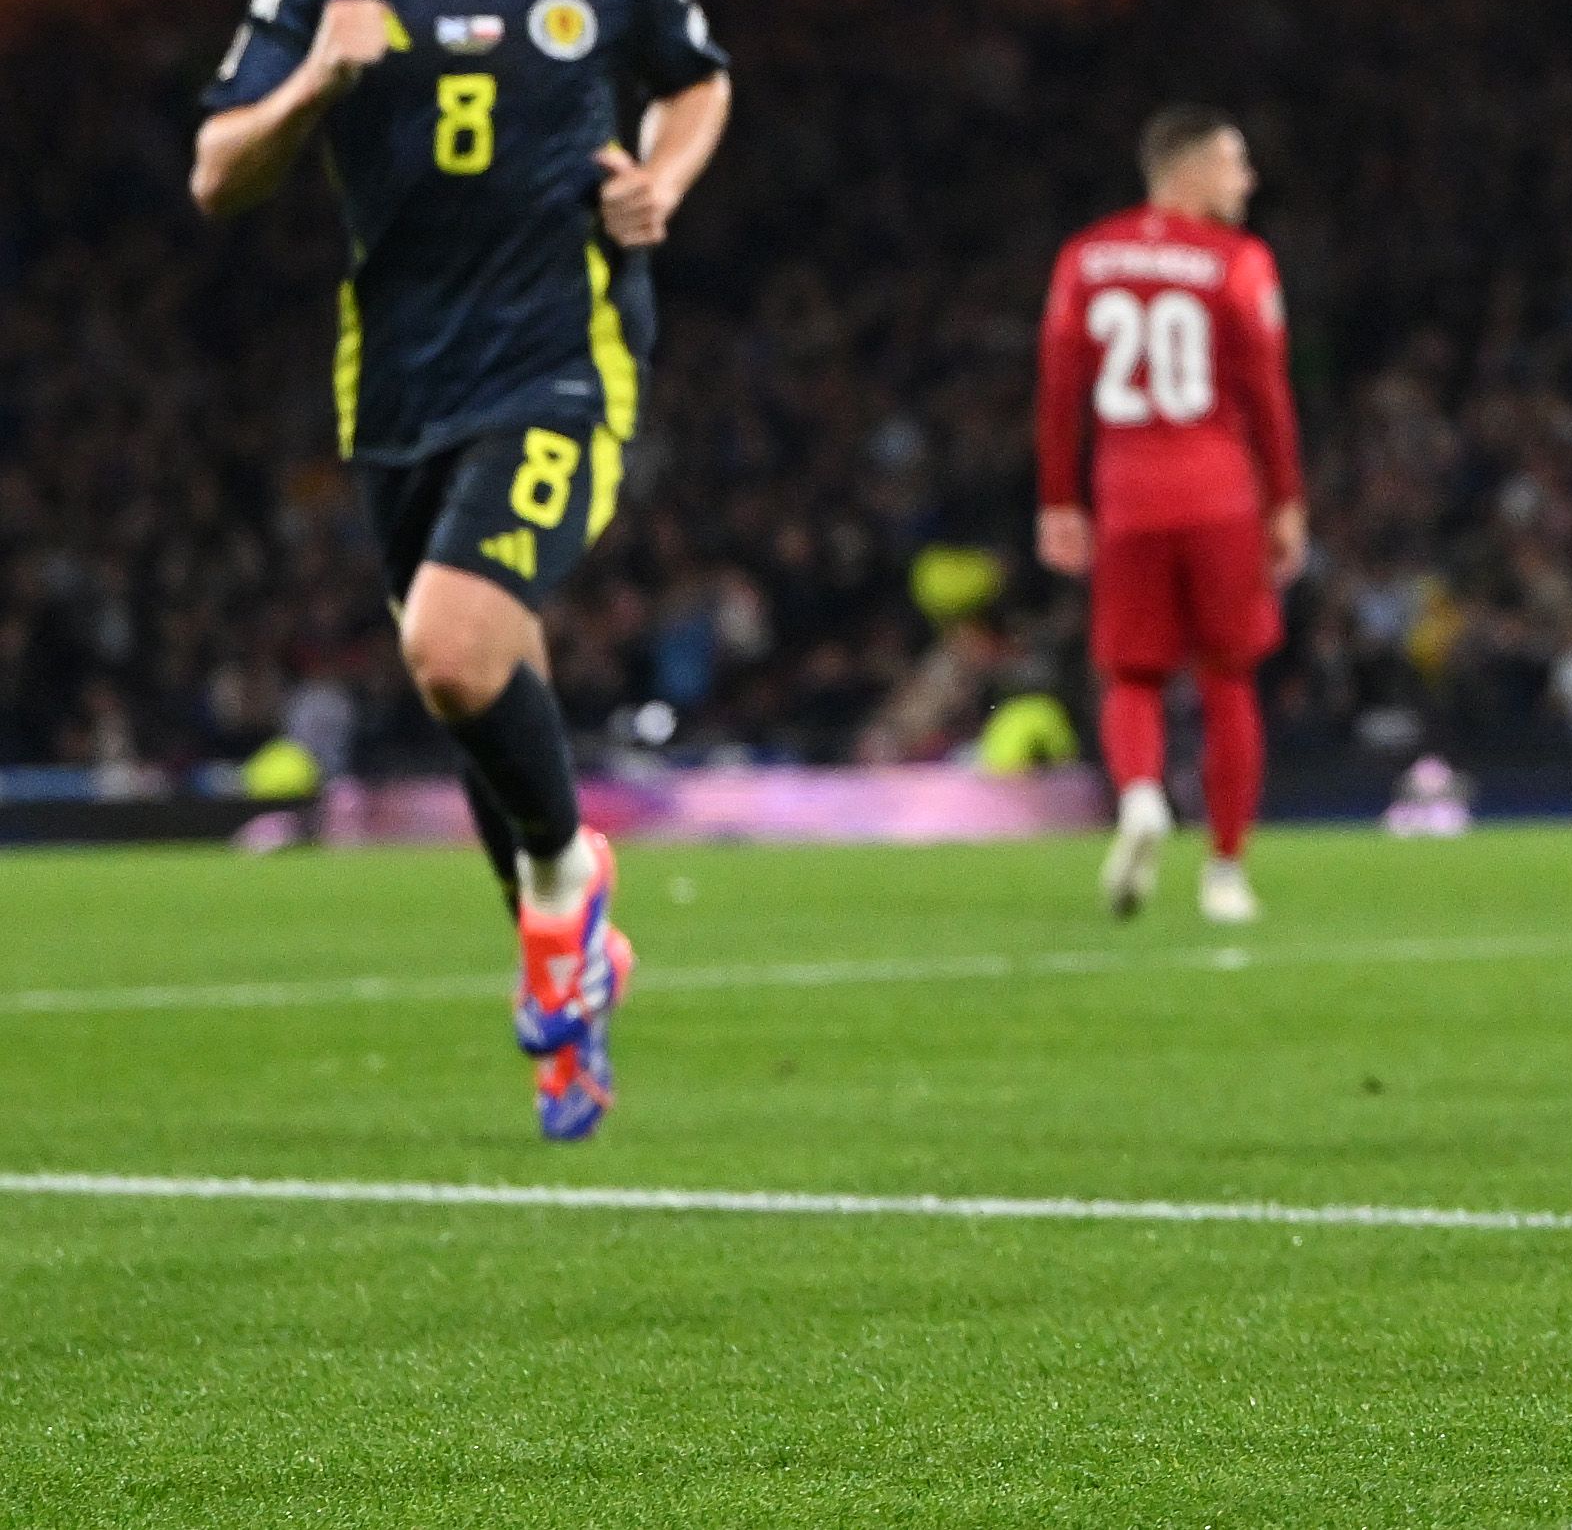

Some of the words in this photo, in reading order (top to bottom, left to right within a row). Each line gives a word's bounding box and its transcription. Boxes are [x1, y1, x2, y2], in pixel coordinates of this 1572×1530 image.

[434, 73, 498, 177] 8
[1086, 287, 1217, 425] 20
[509, 426, 581, 529] 8
